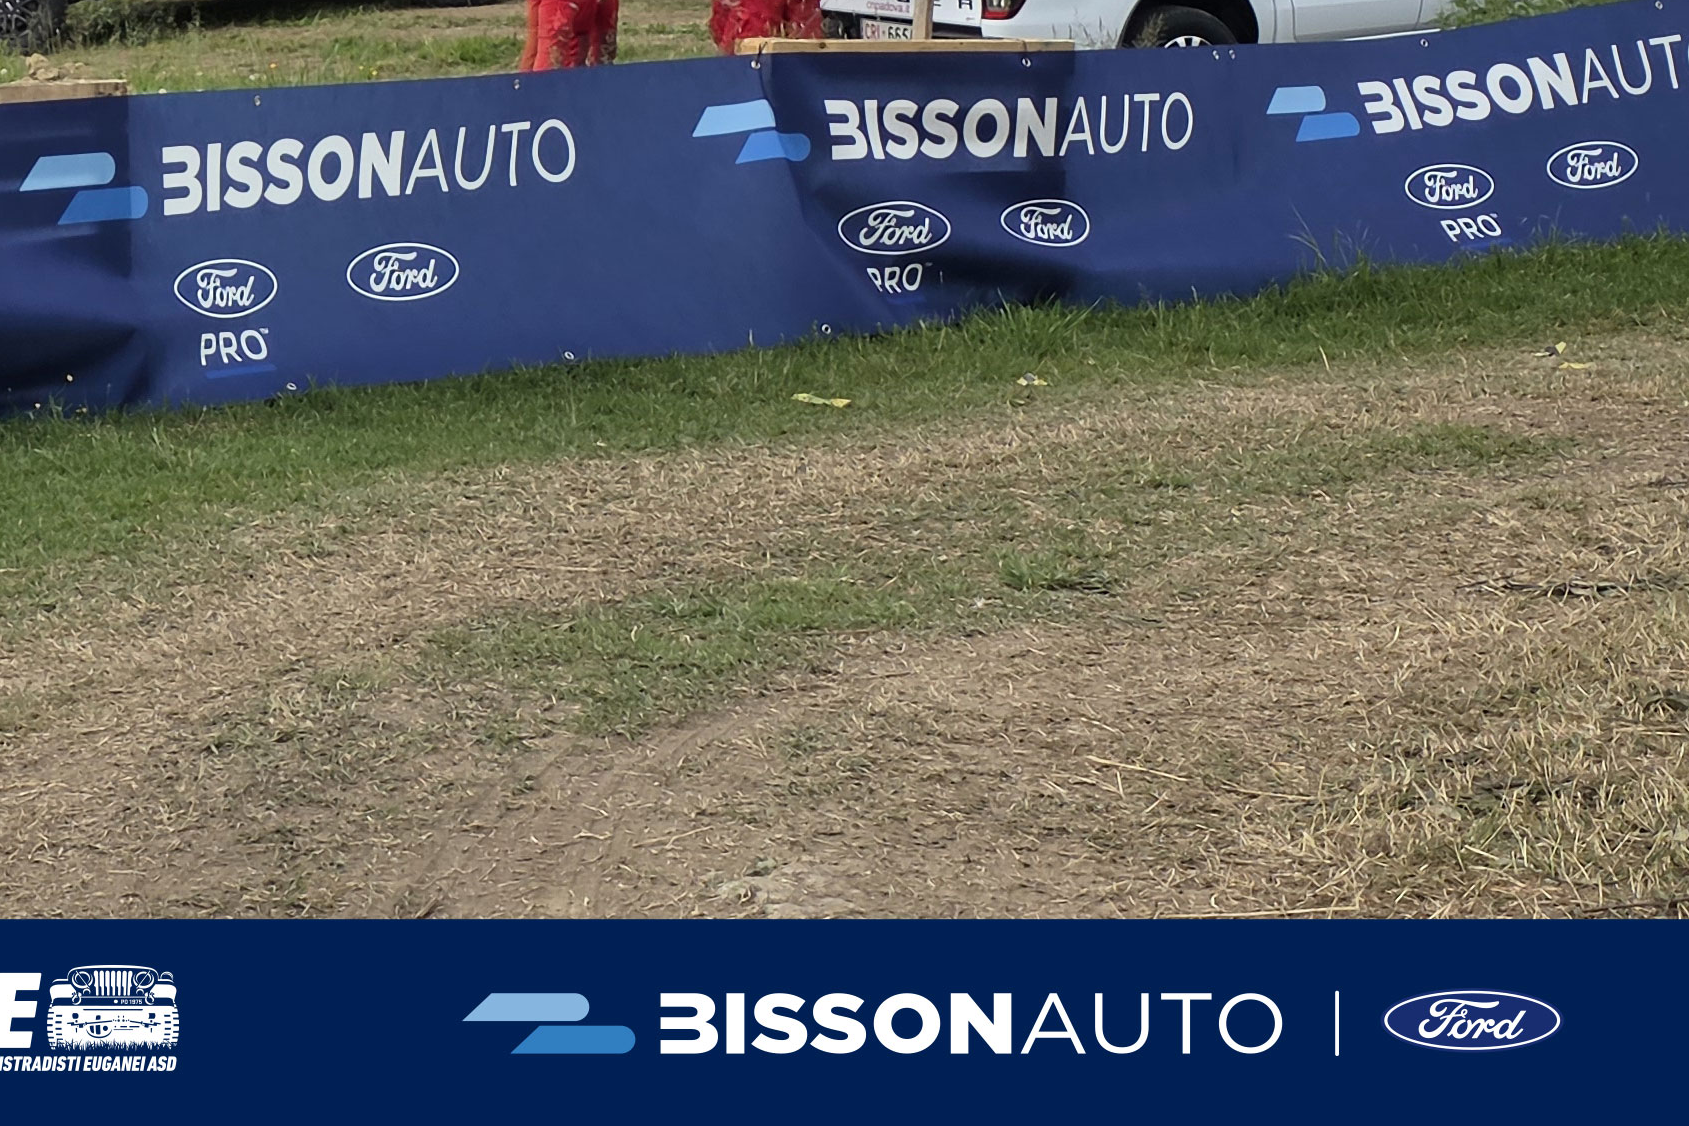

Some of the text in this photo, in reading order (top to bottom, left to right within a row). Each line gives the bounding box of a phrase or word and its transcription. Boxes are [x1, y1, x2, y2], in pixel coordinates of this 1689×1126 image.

[864, 23, 913, 39] CRI 665
[1358, 35, 1689, 134] BISSONAUT
[824, 92, 1193, 160] BISSONAUTO
[162, 119, 575, 215] BISSONAUTO
[1567, 148, 1621, 182] Ford
[1424, 171, 1478, 202] Ford
[859, 209, 932, 245] Ford
[1020, 207, 1072, 240] Ford
[197, 268, 254, 309] Ford
[370, 251, 437, 292] Ford
